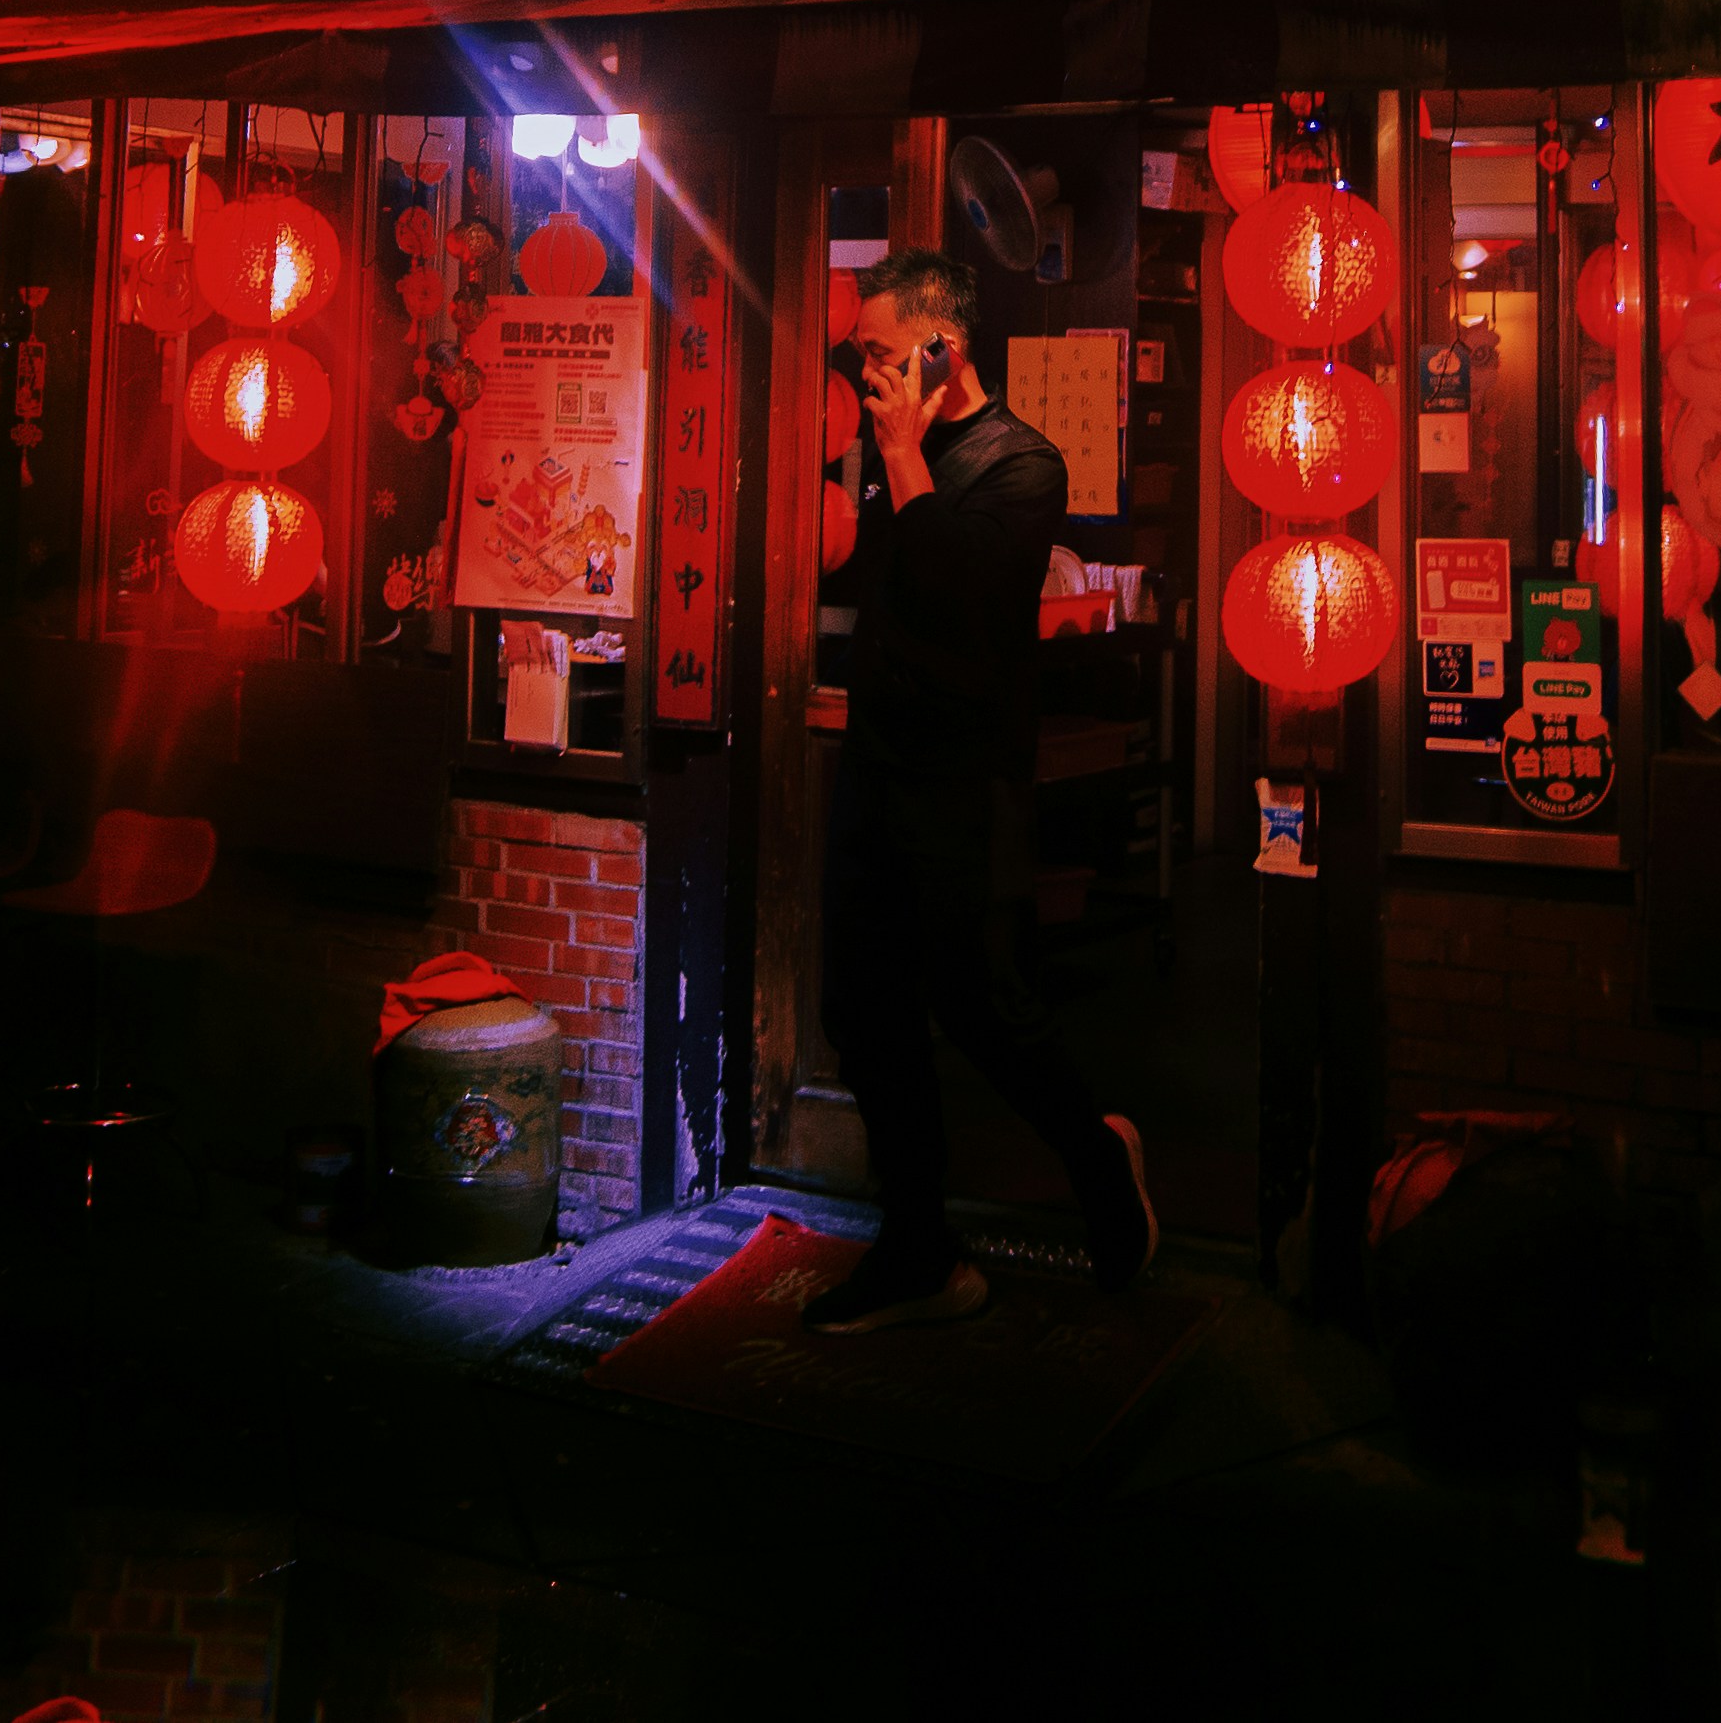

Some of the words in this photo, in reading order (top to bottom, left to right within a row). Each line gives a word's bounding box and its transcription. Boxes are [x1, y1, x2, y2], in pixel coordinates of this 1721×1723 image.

[1530, 591, 1561, 606] LINE
[1539, 681, 1564, 694] LINE
[1566, 681, 1586, 696] Pay
[1512, 745, 1602, 780] 台灣豬
[1525, 790, 1567, 814] TAIWAN
